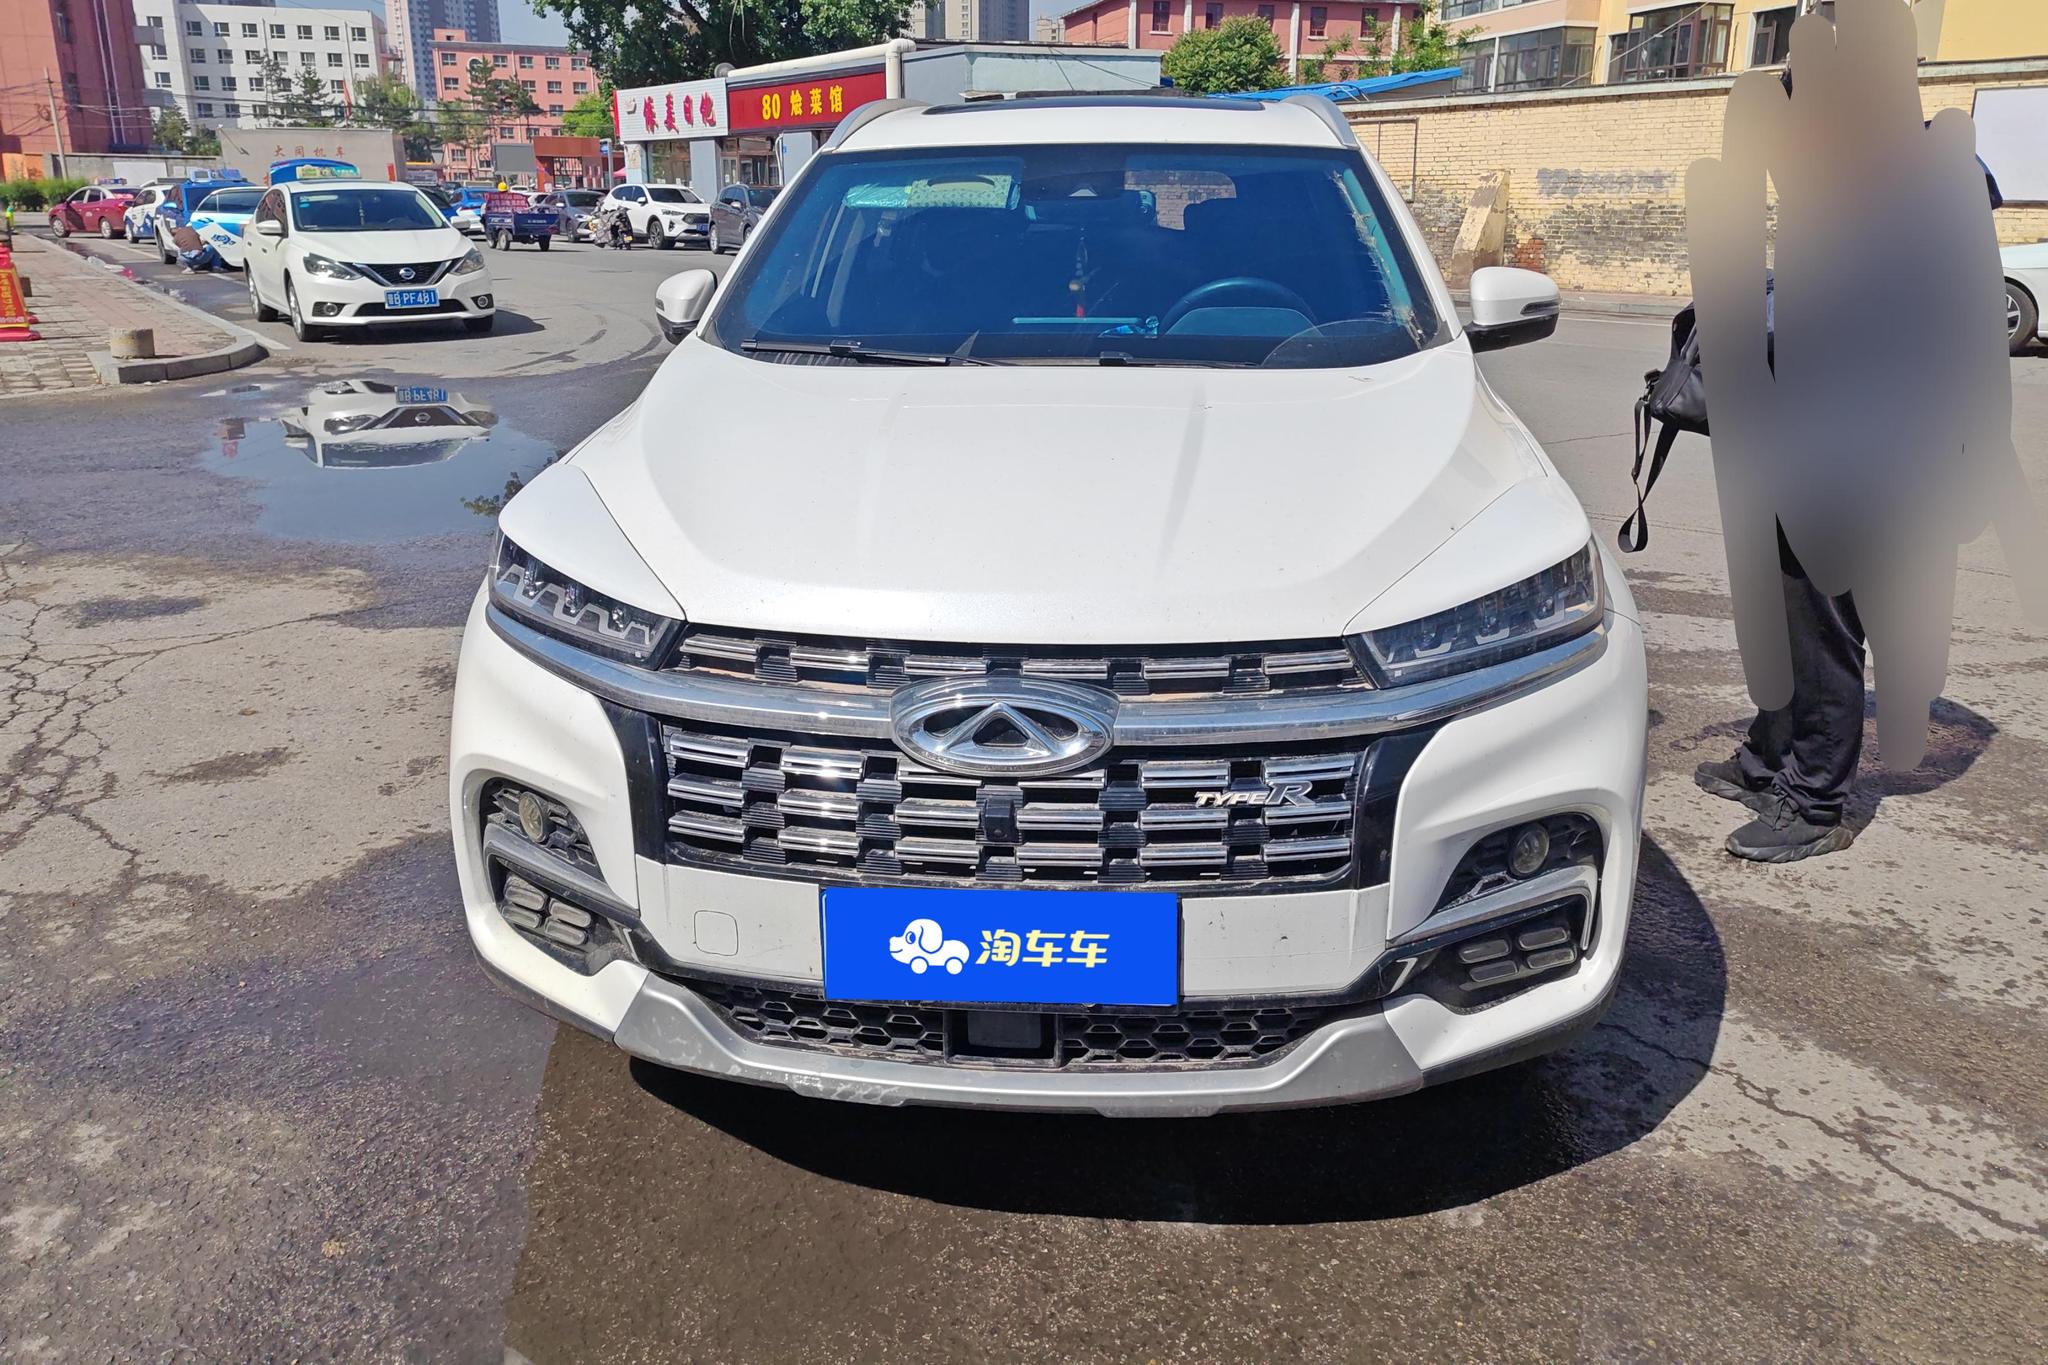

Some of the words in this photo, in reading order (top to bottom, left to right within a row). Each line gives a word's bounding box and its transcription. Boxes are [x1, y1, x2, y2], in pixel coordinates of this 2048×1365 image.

[762, 94, 780, 119] 80
[790, 85, 842, 116] 烩菜馆
